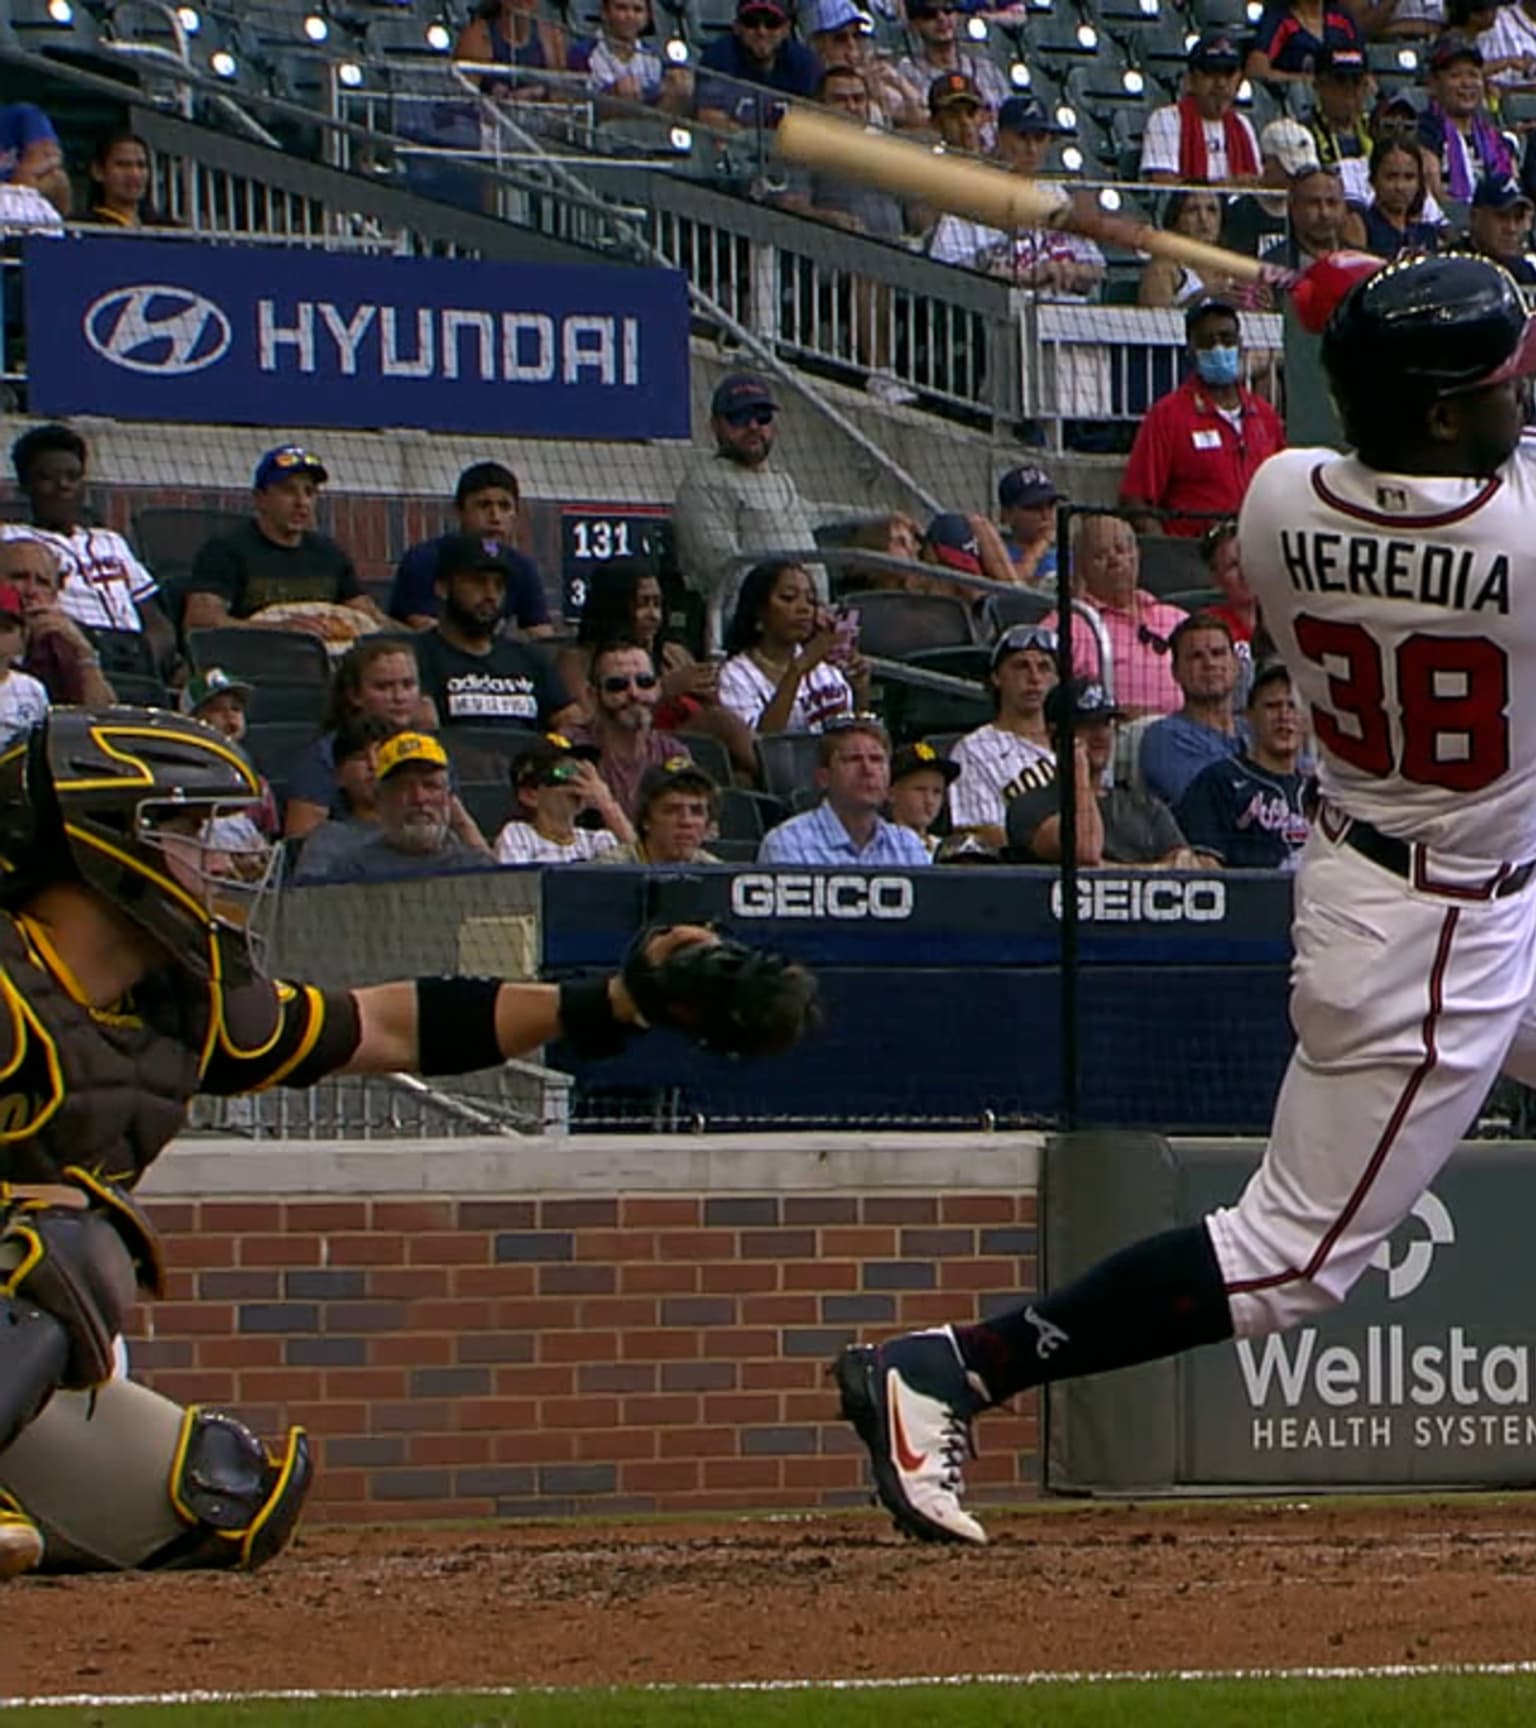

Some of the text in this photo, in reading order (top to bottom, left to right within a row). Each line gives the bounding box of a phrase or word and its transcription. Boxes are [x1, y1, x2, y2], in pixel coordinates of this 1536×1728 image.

[259, 299, 639, 386] HYUNDAI
[573, 520, 634, 559] 131
[1280, 529, 1510, 615] HEREDIA
[1293, 611, 1511, 793] 38
[729, 875, 915, 919] GEICO
[1252, 1416, 1392, 1449] HEALTH
